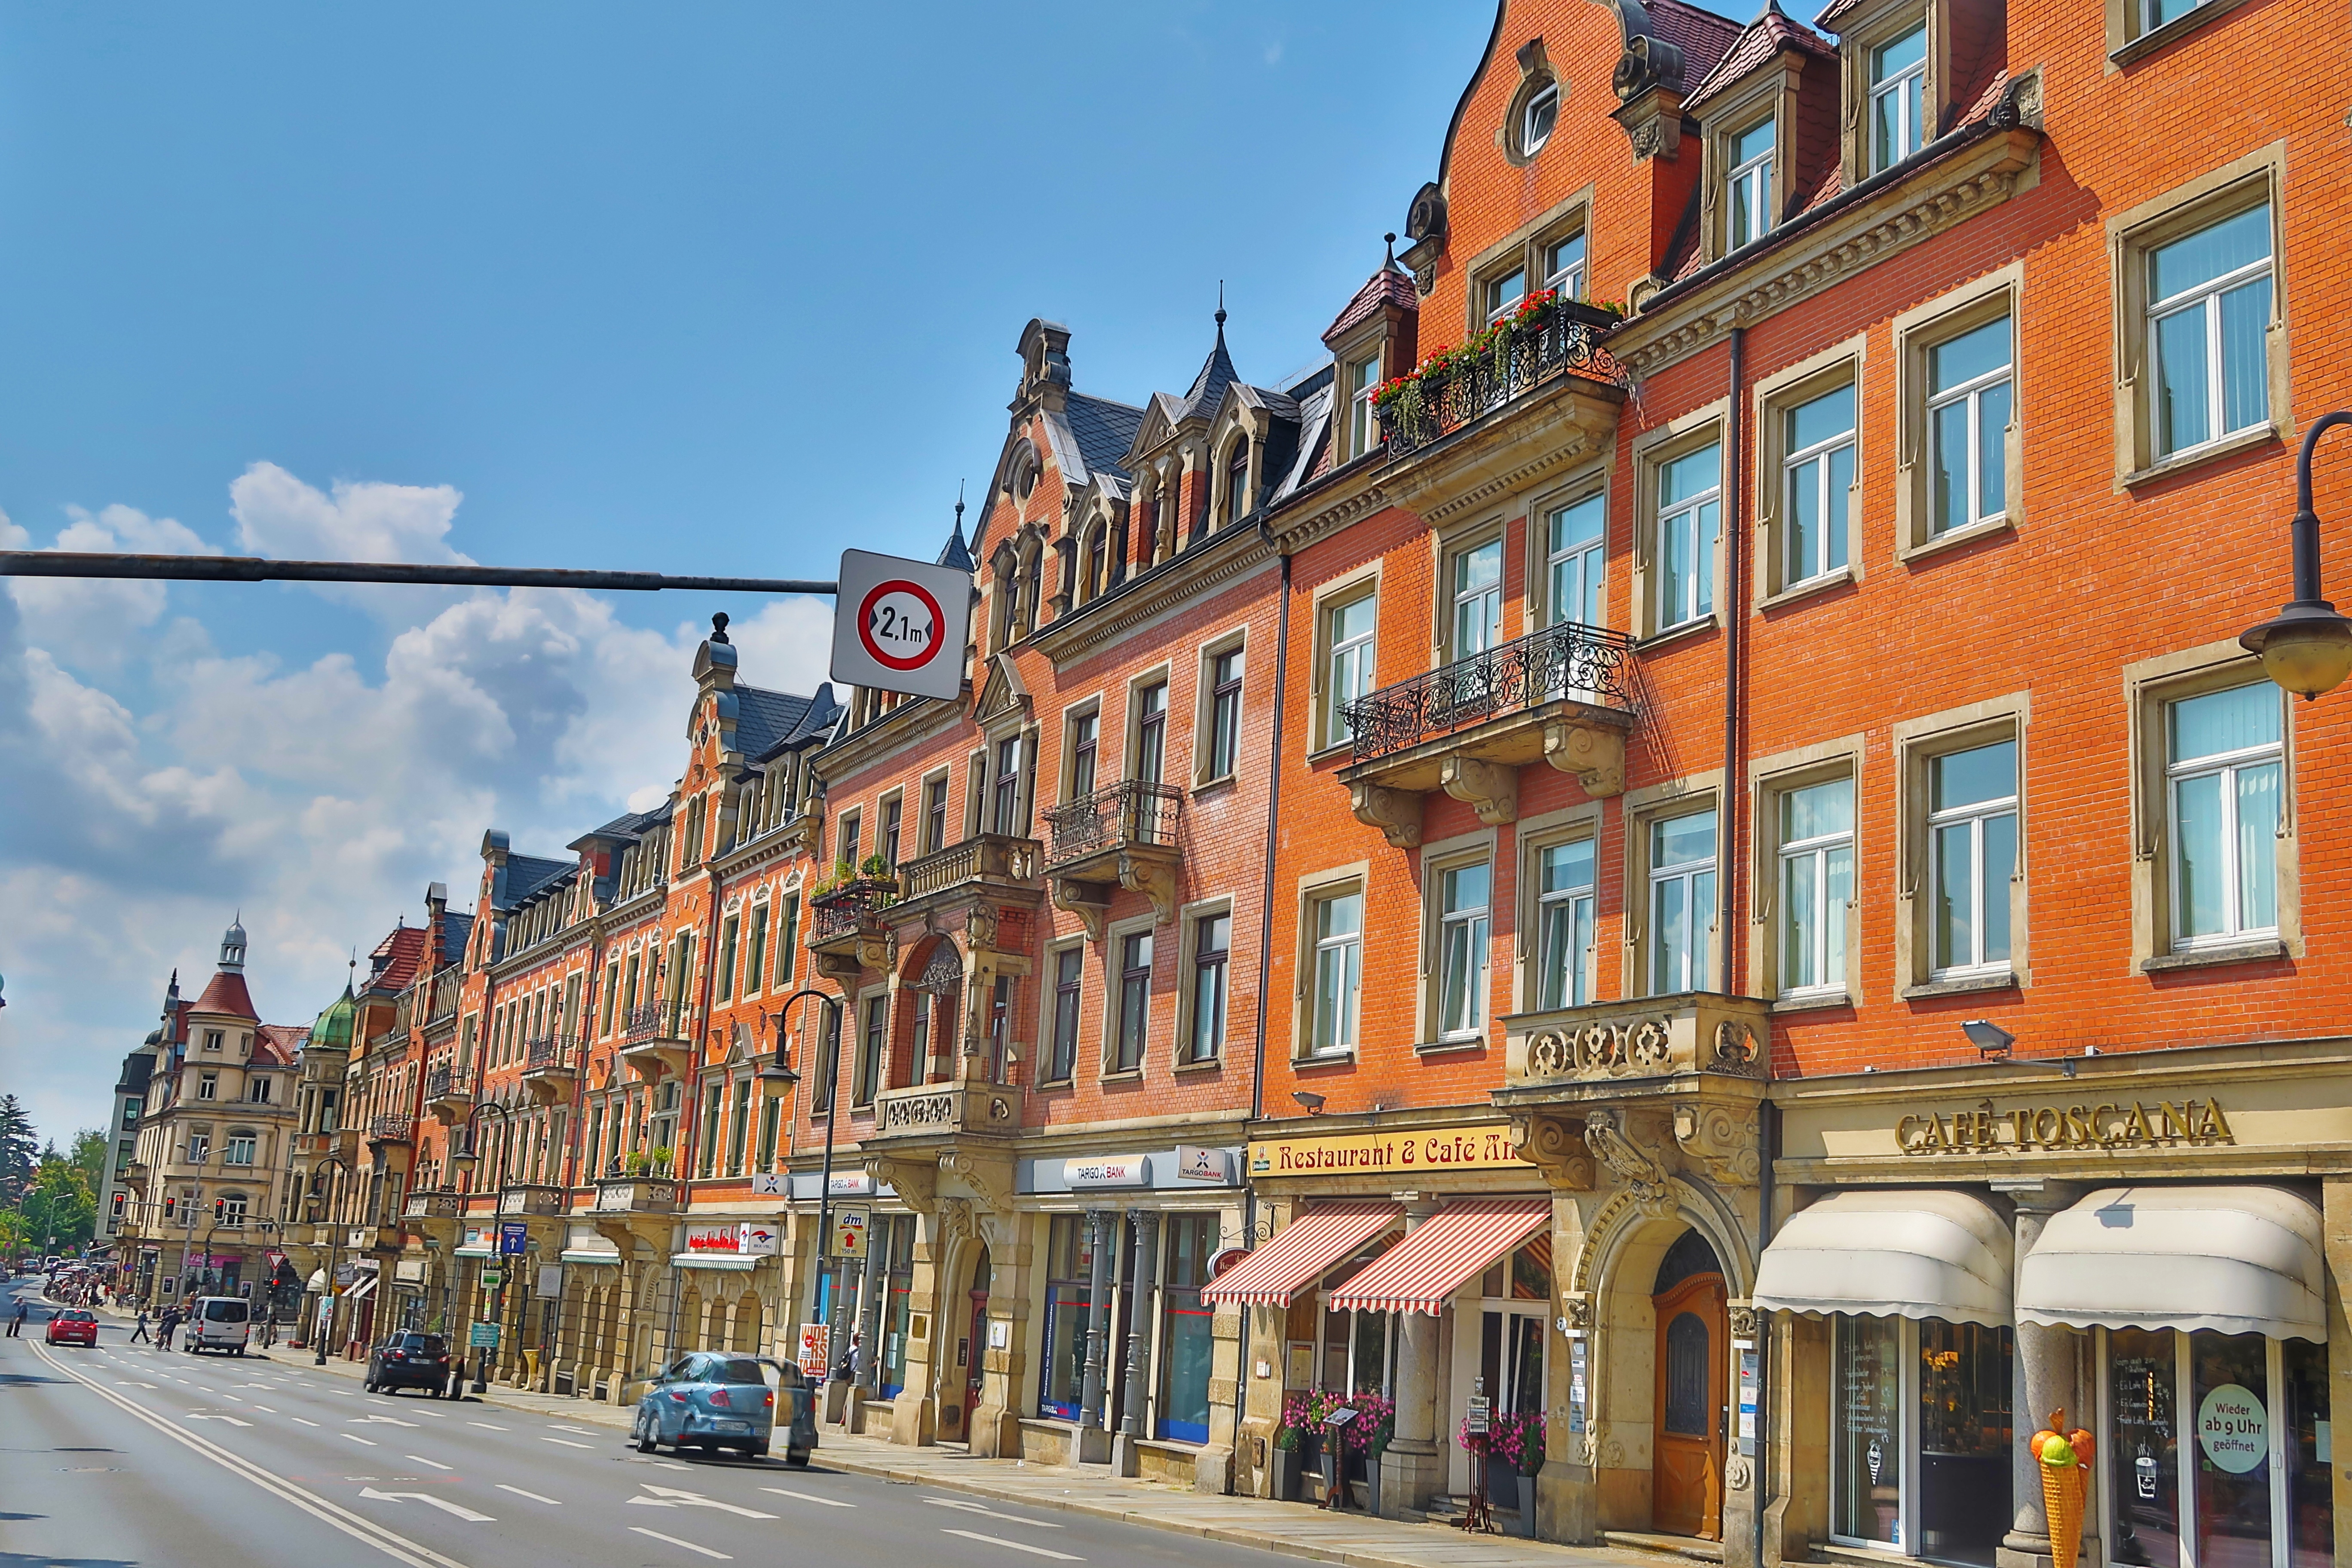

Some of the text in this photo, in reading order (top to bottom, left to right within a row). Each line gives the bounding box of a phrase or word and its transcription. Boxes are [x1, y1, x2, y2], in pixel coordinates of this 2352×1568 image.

[2005, 1097, 2230, 1146] TOSCANA
[1279, 1141, 1393, 1169] Restaurant
[1402, 1140, 1415, 1164] &
[1426, 1136, 1475, 1163] Café
[1182, 1168, 1222, 1178] TARGOBANK
[843, 1213, 861, 1225] dm
[2216, 1403, 2250, 1415] Wieder
[2206, 1417, 2262, 1435] ab 9 Uhr
[2214, 1439, 2254, 1452] geöffnet
